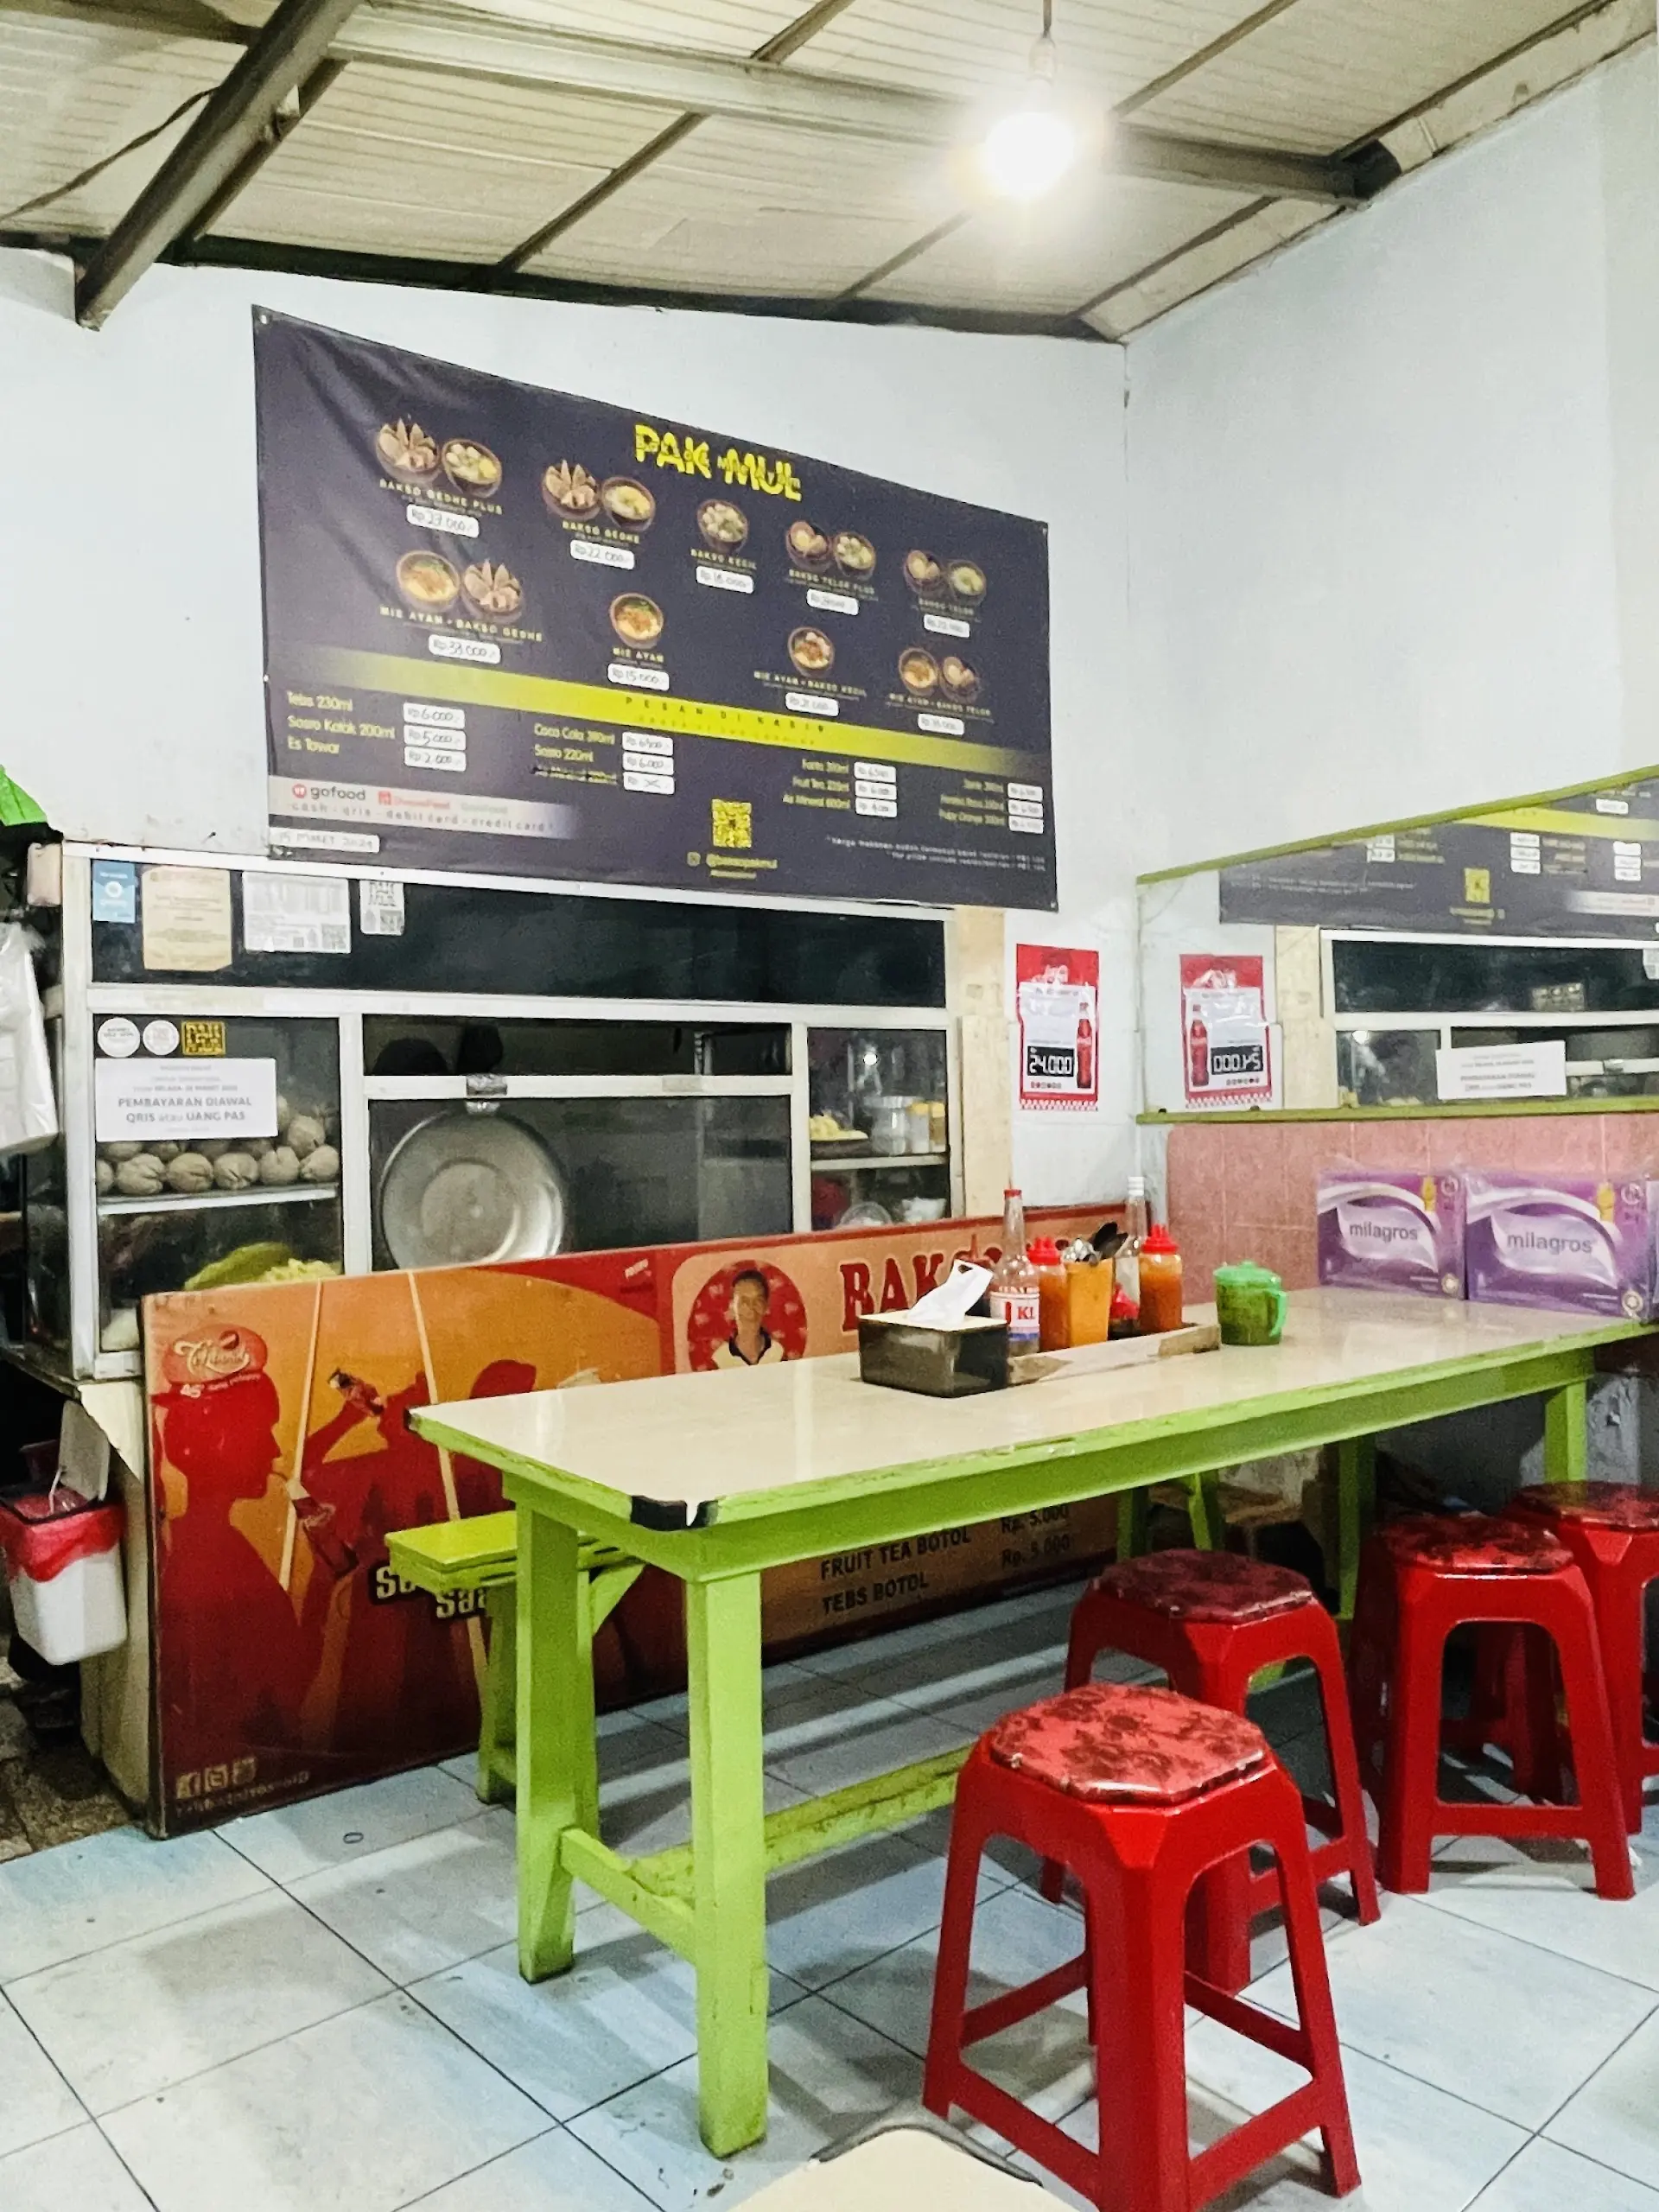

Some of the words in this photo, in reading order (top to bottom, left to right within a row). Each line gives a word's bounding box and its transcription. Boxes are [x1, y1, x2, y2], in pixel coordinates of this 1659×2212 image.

[635, 424, 712, 479] PAK
[719, 448, 802, 501] MUL
[380, 478, 421, 496] BAKSO
[473, 499, 502, 515] PLUS
[563, 520, 600, 536] BAKSO
[690, 549, 724, 562] BAKSO
[379, 606, 403, 619] MIE
[409, 611, 443, 624] AYAM
[456, 619, 498, 633] BAKSO
[613, 647, 631, 658] MIE
[636, 651, 664, 663] AYAM
[626, 697, 702, 715] PESAN
[288, 735, 302, 751] Es
[310, 786, 366, 802] gofood
[292, 802, 327, 812] cash
[118, 1097, 202, 1109] PEMBAYARAN
[206, 1096, 252, 1107] DIAWAL
[126, 1111, 156, 1123] QRIS
[186, 1111, 221, 1122] UANG
[224, 1110, 245, 1121] PAS
[1349, 1222, 1418, 1243] milagros
[1507, 1232, 1593, 1255] milagros
[821, 1548, 873, 1580] FRUIT
[879, 1541, 912, 1565] TEA
[917, 1527, 972, 1555] BOTOL
[822, 1588, 867, 1614] TEBS
[873, 1572, 930, 1599] BOTOL
